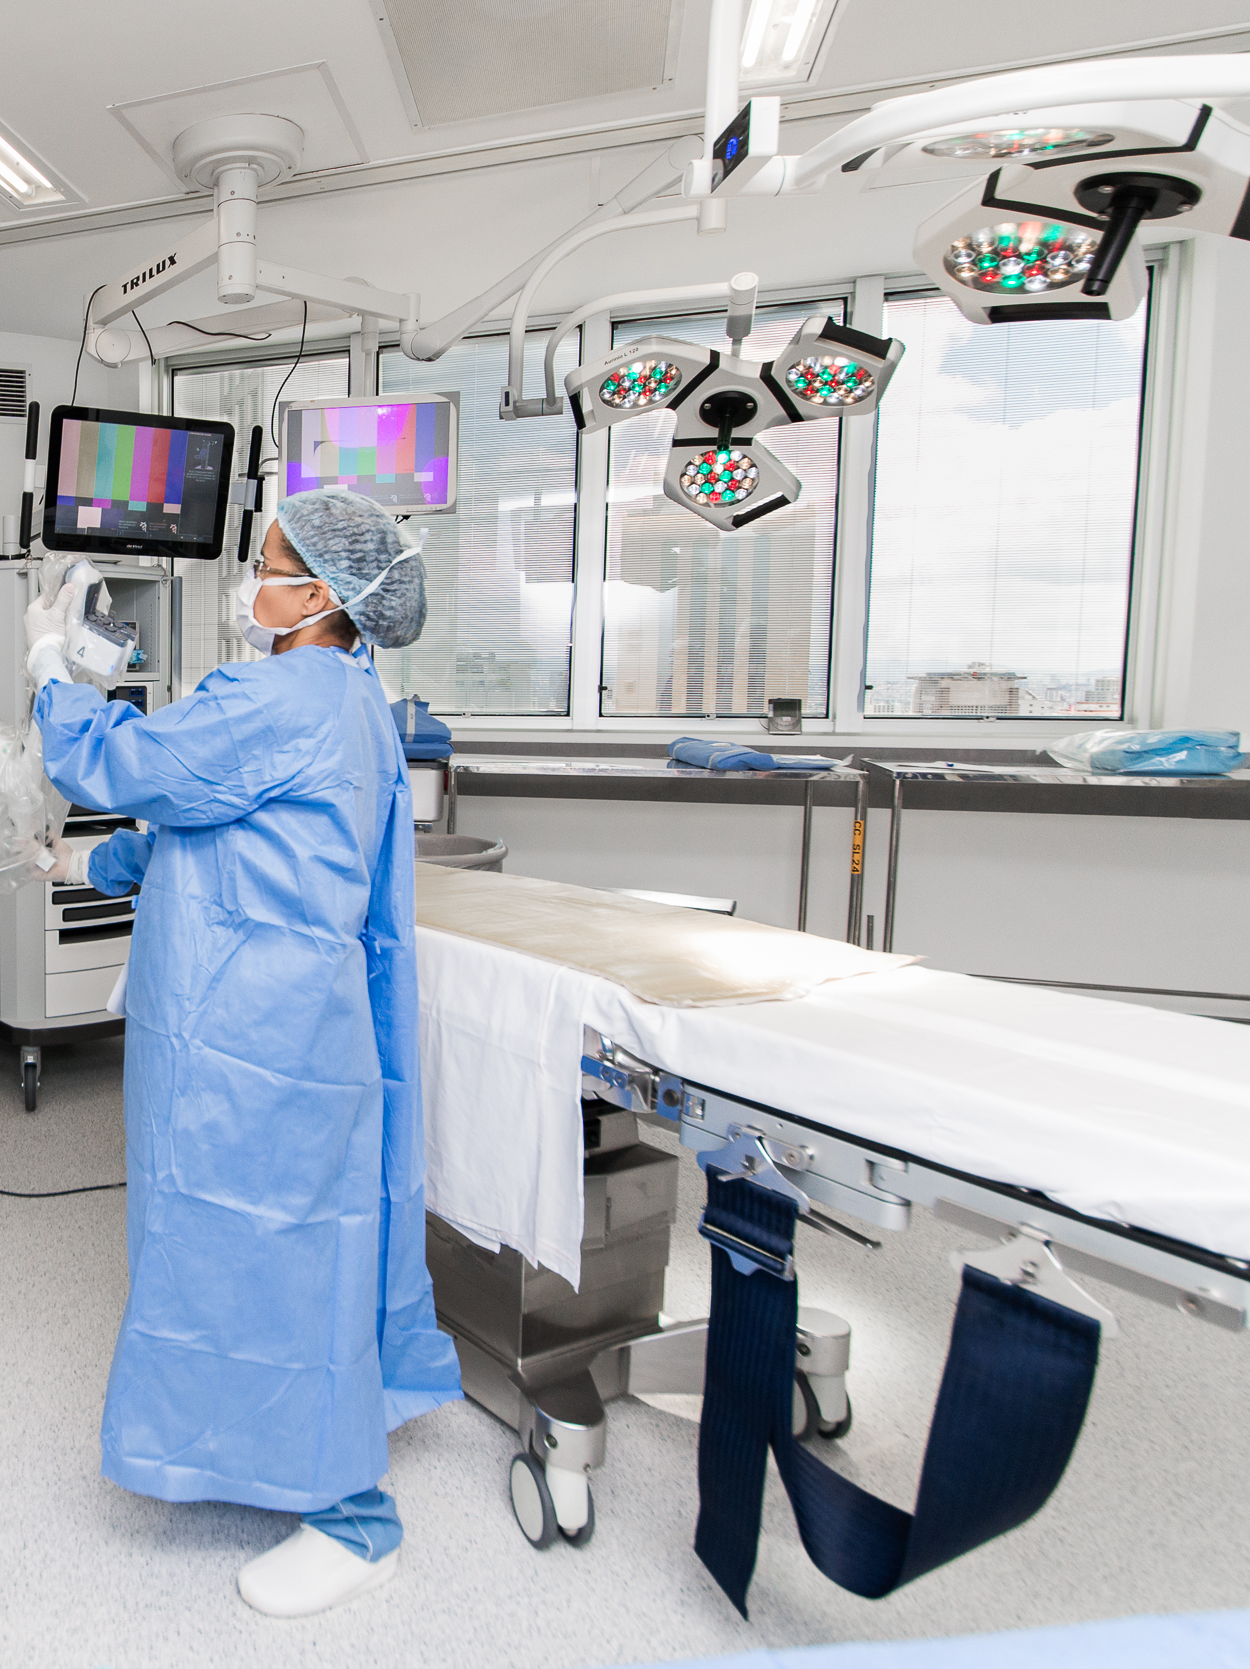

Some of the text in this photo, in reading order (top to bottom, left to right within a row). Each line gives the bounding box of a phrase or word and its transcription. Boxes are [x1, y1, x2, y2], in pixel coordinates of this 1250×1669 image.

[121, 251, 178, 295] TRILUX
[77, 645, 86, 658] 4
[851, 821, 862, 873] CC SL24
